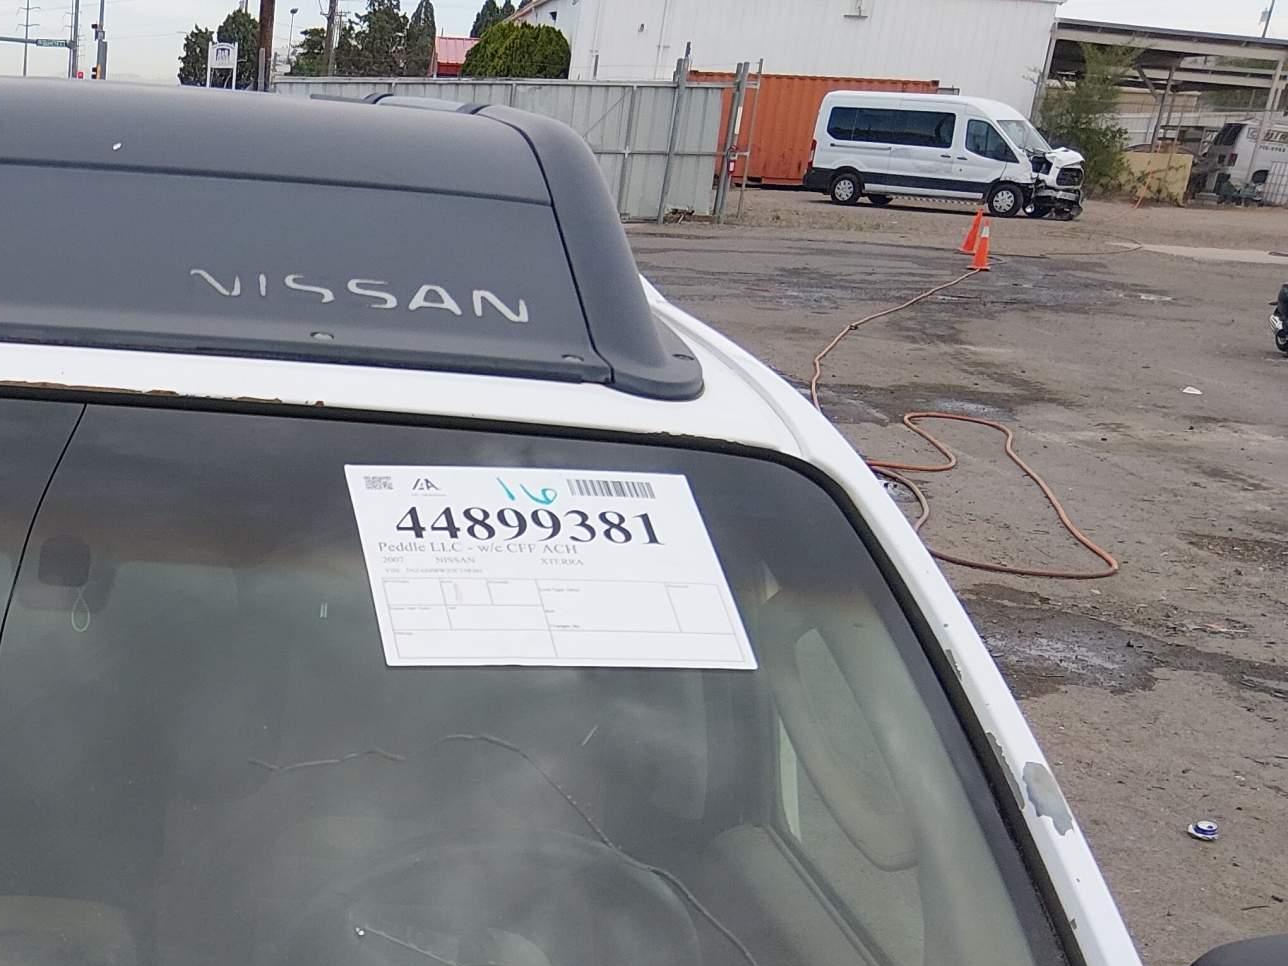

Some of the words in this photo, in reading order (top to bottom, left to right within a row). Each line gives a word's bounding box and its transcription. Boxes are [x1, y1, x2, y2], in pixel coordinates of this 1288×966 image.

[190, 268, 529, 323] NISSAN
[396, 506, 665, 546] 44899381
[378, 541, 425, 553] Peddle
[430, 541, 462, 553] LLC
[542, 544, 577, 555] ACH
